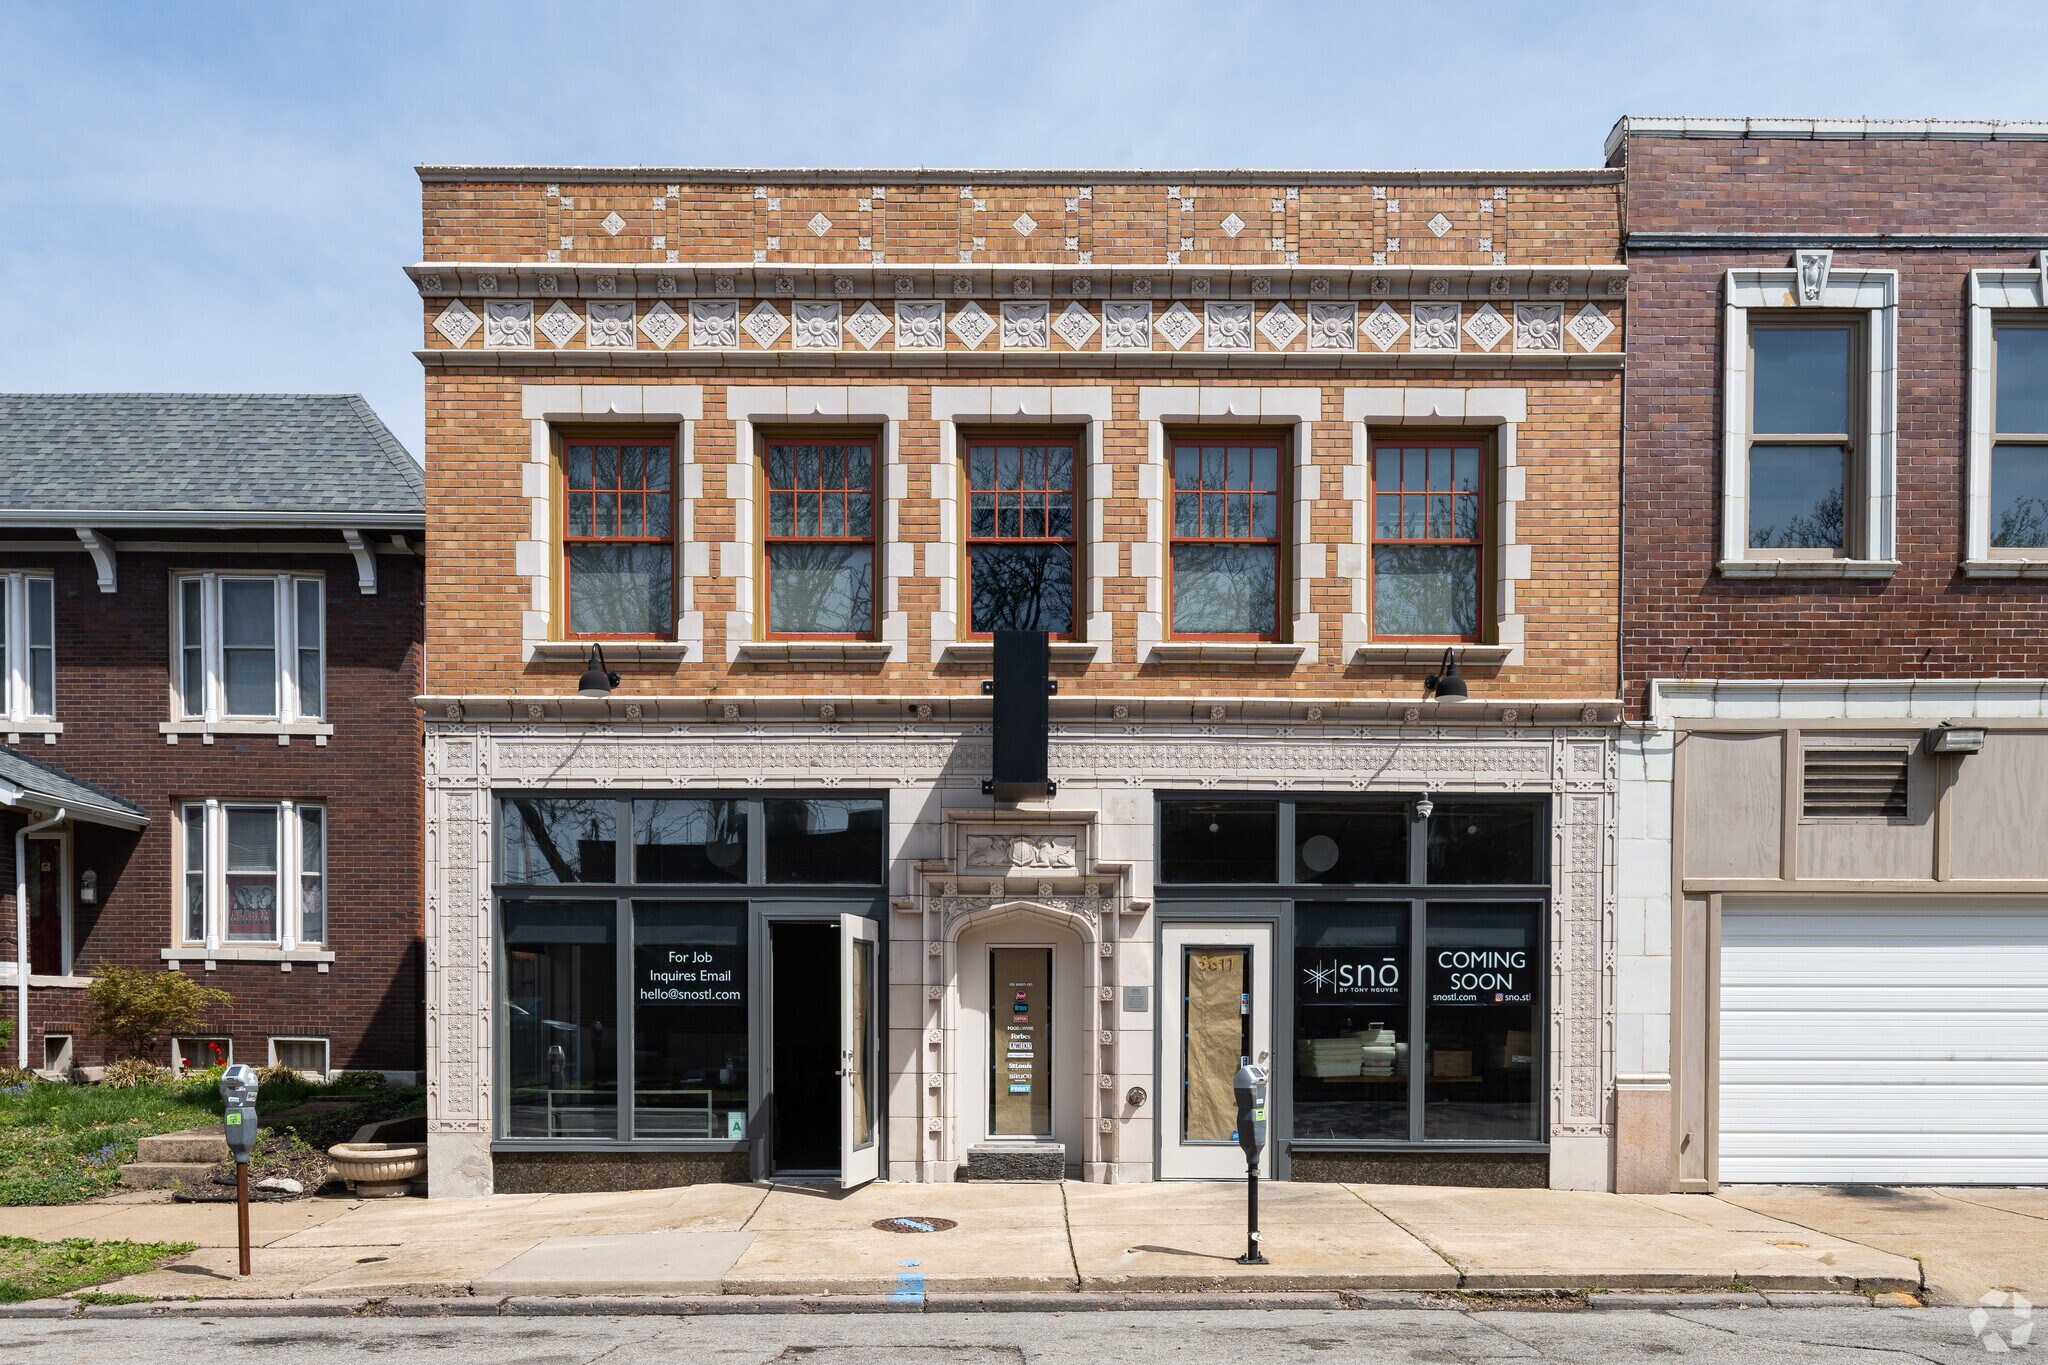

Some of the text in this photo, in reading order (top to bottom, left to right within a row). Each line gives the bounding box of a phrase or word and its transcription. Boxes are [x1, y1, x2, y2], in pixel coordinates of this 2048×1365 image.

[231, 909, 276, 921] ALABAM
[669, 951, 713, 963] For Job
[1438, 951, 1526, 969] COMING
[650, 969, 731, 984] Inquires Email
[1450, 973, 1513, 990] SOON
[640, 988, 740, 1000] hello@snostl.com
[1432, 993, 1477, 1001] snostl.com
[1504, 993, 1531, 1001] sno.stl
[732, 1122, 742, 1132] A
